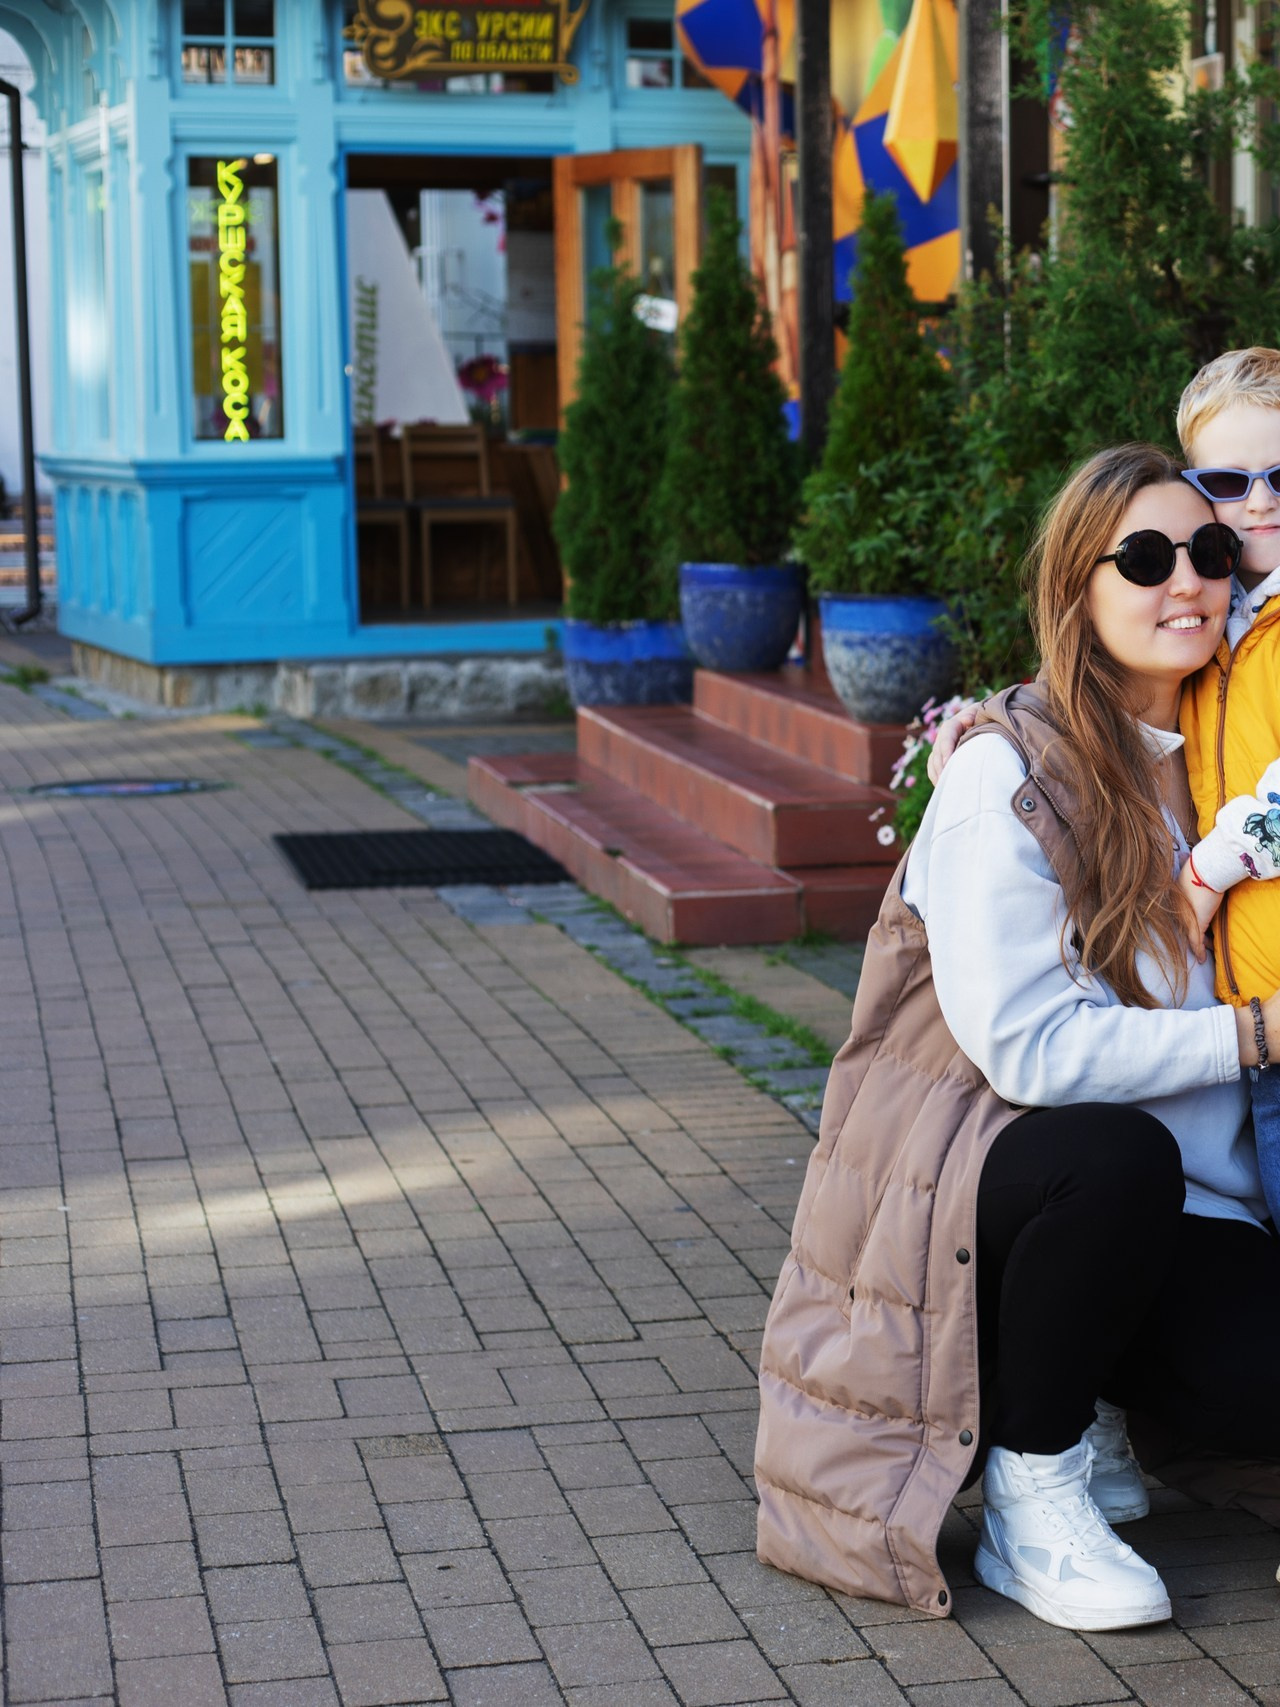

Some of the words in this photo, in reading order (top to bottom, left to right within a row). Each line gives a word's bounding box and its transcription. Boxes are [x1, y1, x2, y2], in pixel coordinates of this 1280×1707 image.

[451, 41, 474, 62] ПО
[476, 41, 553, 62] ОБЛАСТИ
[217, 159, 248, 343] КУРШСКАЯ
[221, 346, 250, 442] КОСА
